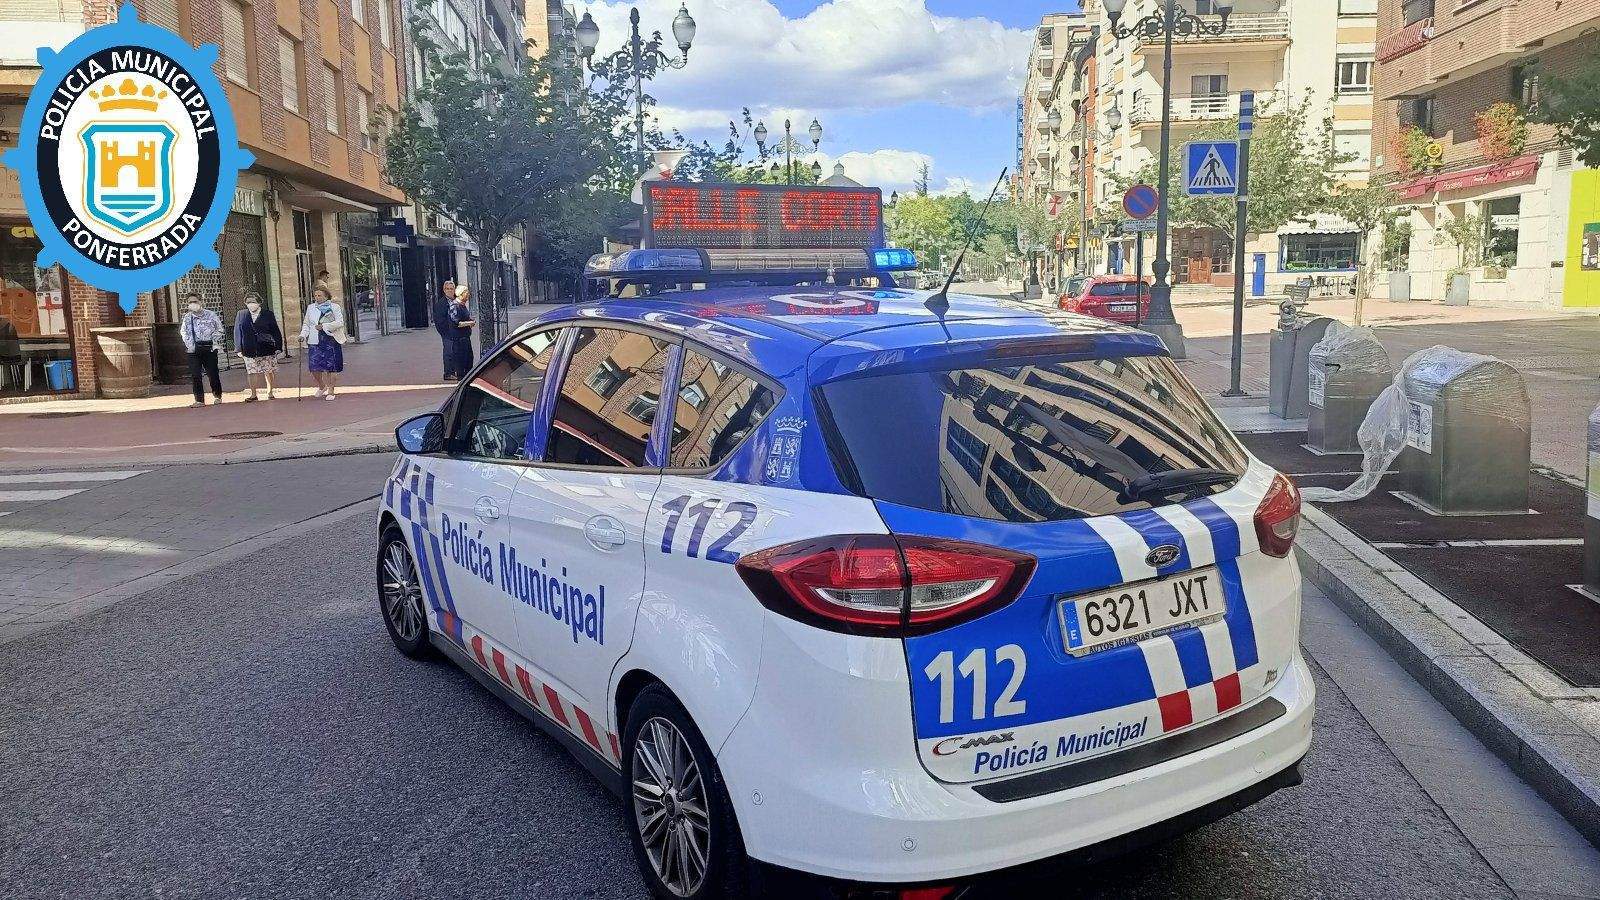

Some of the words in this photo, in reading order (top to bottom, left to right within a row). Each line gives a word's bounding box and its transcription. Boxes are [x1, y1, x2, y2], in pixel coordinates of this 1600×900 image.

[660, 494, 758, 565] 112
[441, 511, 494, 586] Policía
[499, 542, 605, 646] Municipal
[1084, 589, 1152, 637] 6321
[1169, 575, 1208, 618] JXT
[1070, 629, 1078, 641] E
[1089, 641, 1115, 653] AUTOS
[1115, 632, 1150, 648] IGLESIAS
[924, 642, 1028, 725] 112
[973, 740, 1049, 775] Policía
[1055, 716, 1148, 760] Municipal
